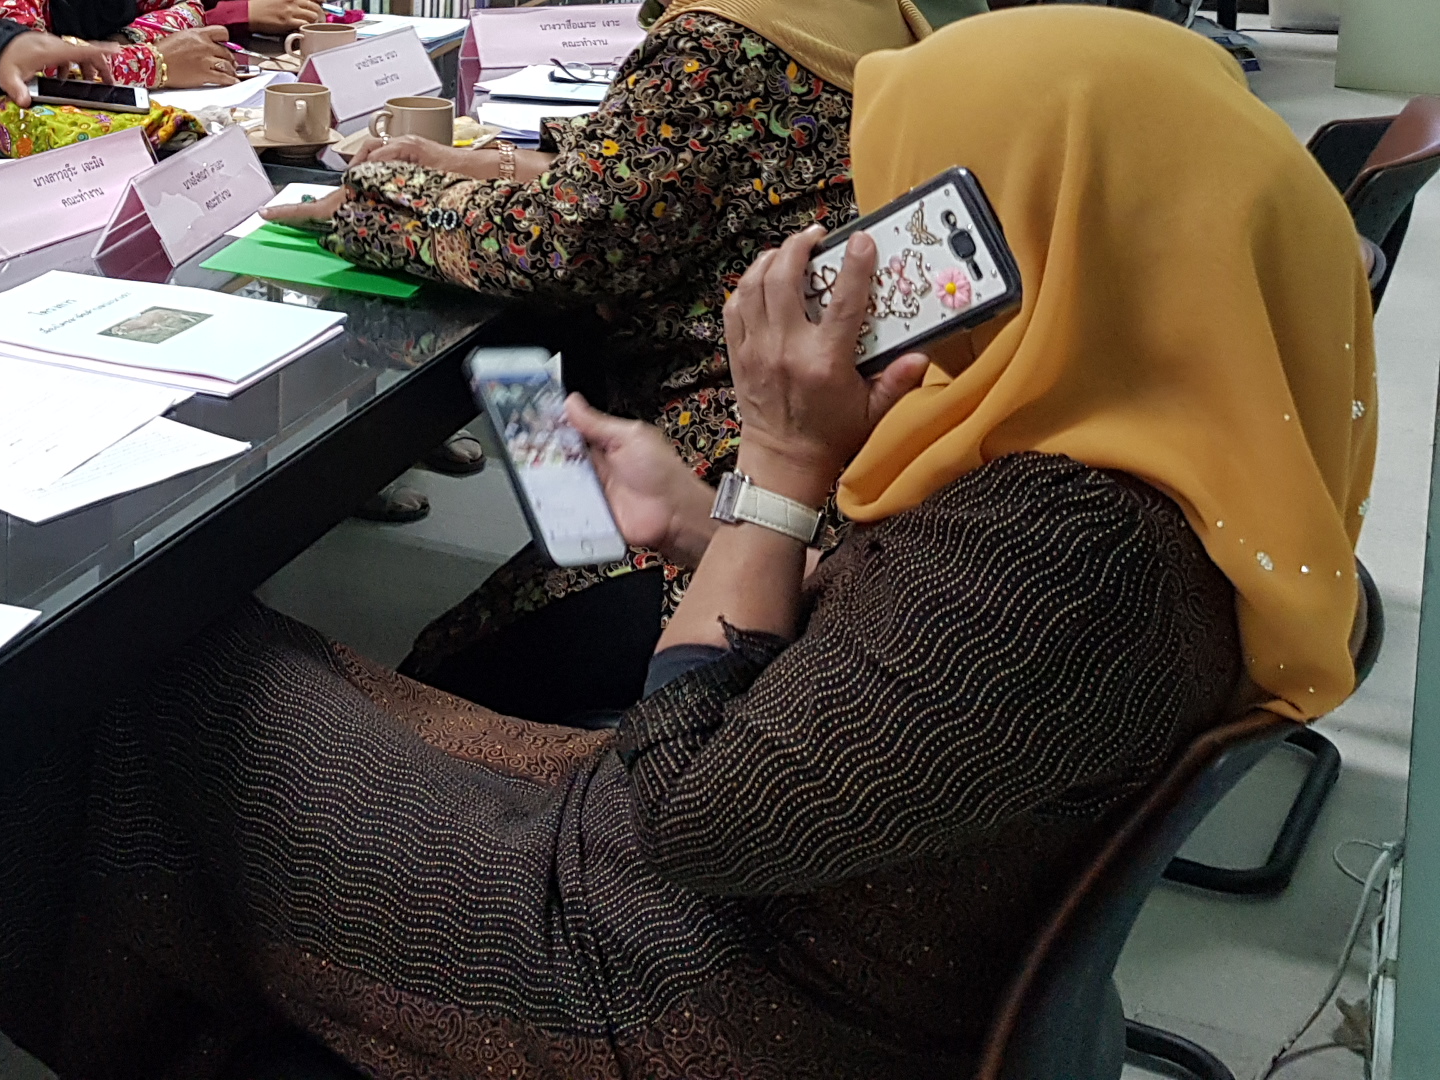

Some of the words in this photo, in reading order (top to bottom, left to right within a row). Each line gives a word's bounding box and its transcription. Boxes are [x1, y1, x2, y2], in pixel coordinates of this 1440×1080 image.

[562, 37, 608, 48] คณะทำงาน
[61, 187, 105, 207] คณะทำงาน
